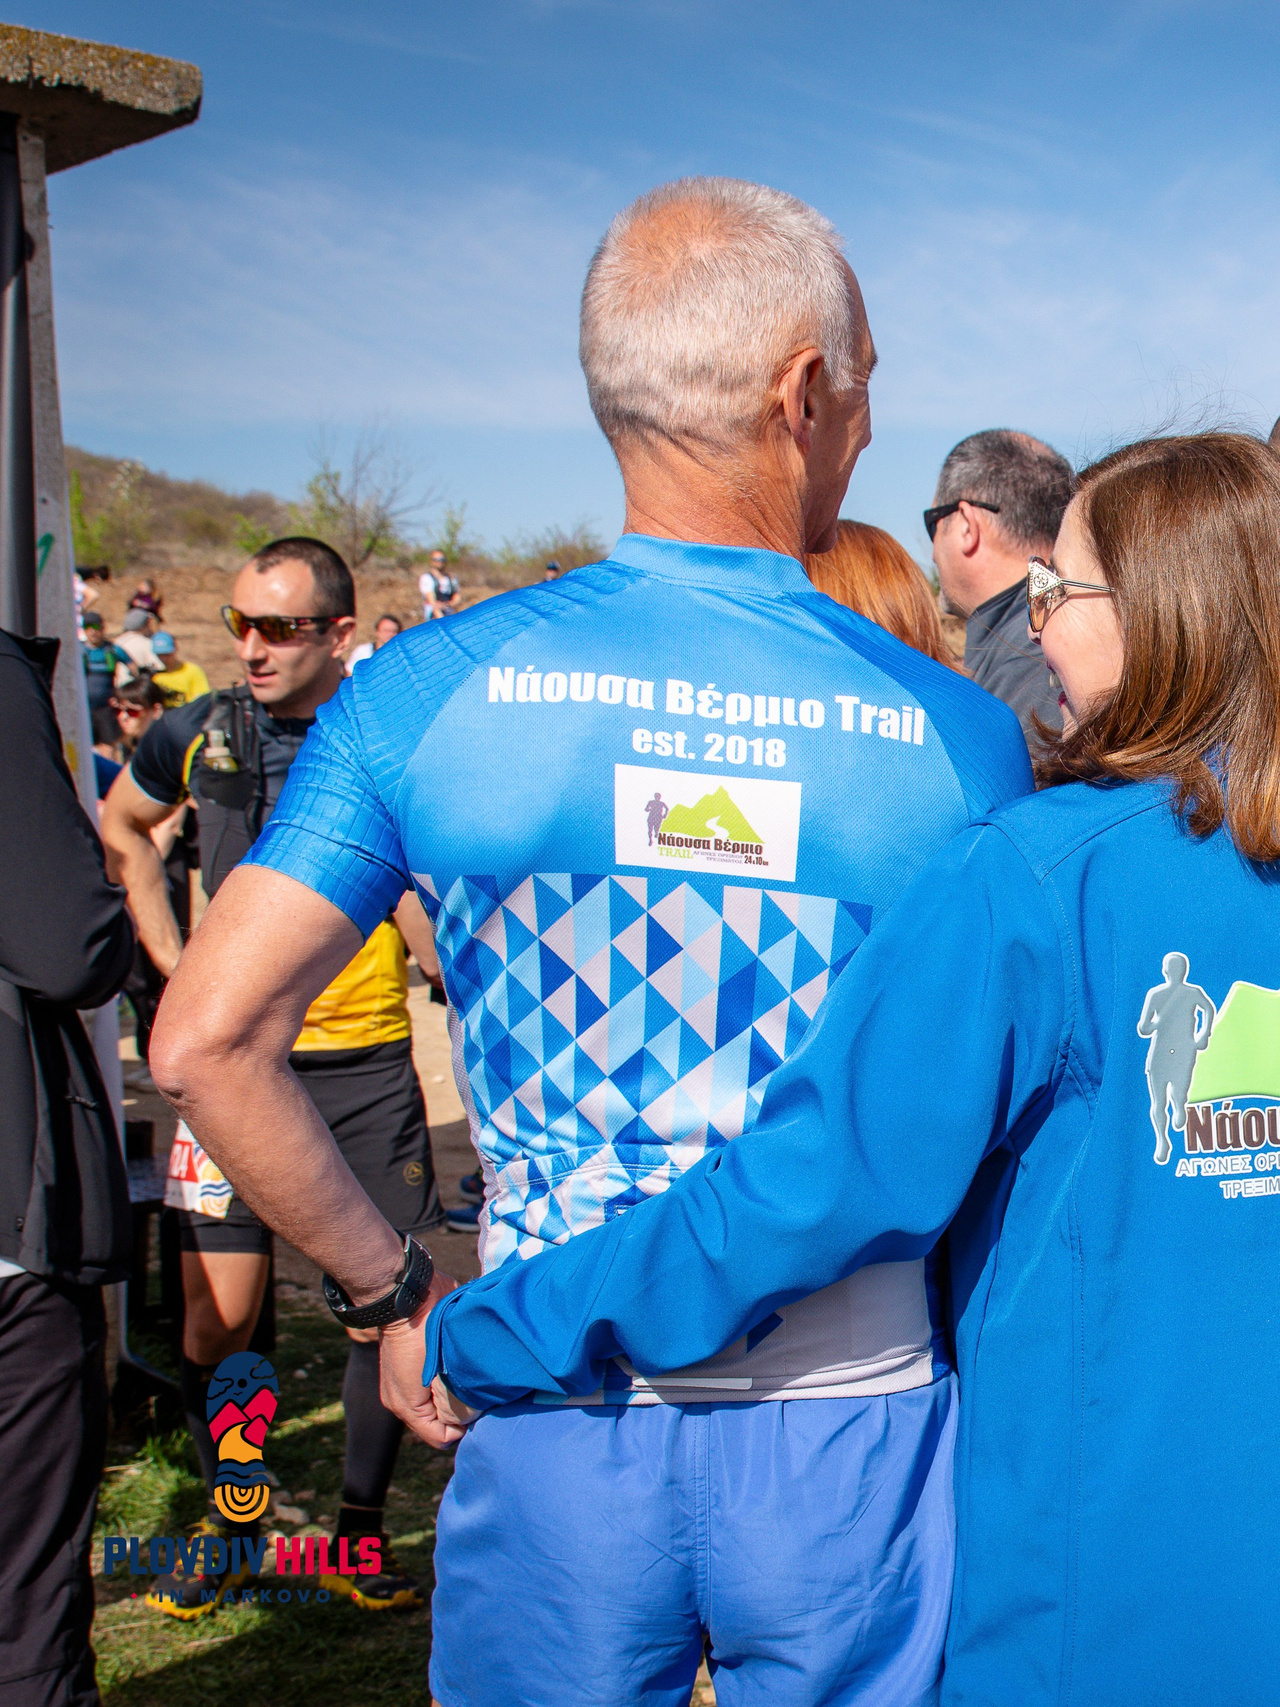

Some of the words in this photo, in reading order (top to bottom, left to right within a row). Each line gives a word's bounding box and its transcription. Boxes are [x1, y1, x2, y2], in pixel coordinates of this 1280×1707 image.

[488, 665, 655, 710] Νάουσα
[666, 679, 825, 728] Βέρμιο
[835, 695, 925, 746] Trail
[632, 728, 695, 760] est.
[703, 732, 786, 768] 2018
[658, 832, 711, 850] Νάουσα
[714, 838, 764, 855] Βέρμιο
[658, 847, 694, 859] TRAIL
[1177, 1154, 1250, 1177] ΑΓΩΝΕΣ
